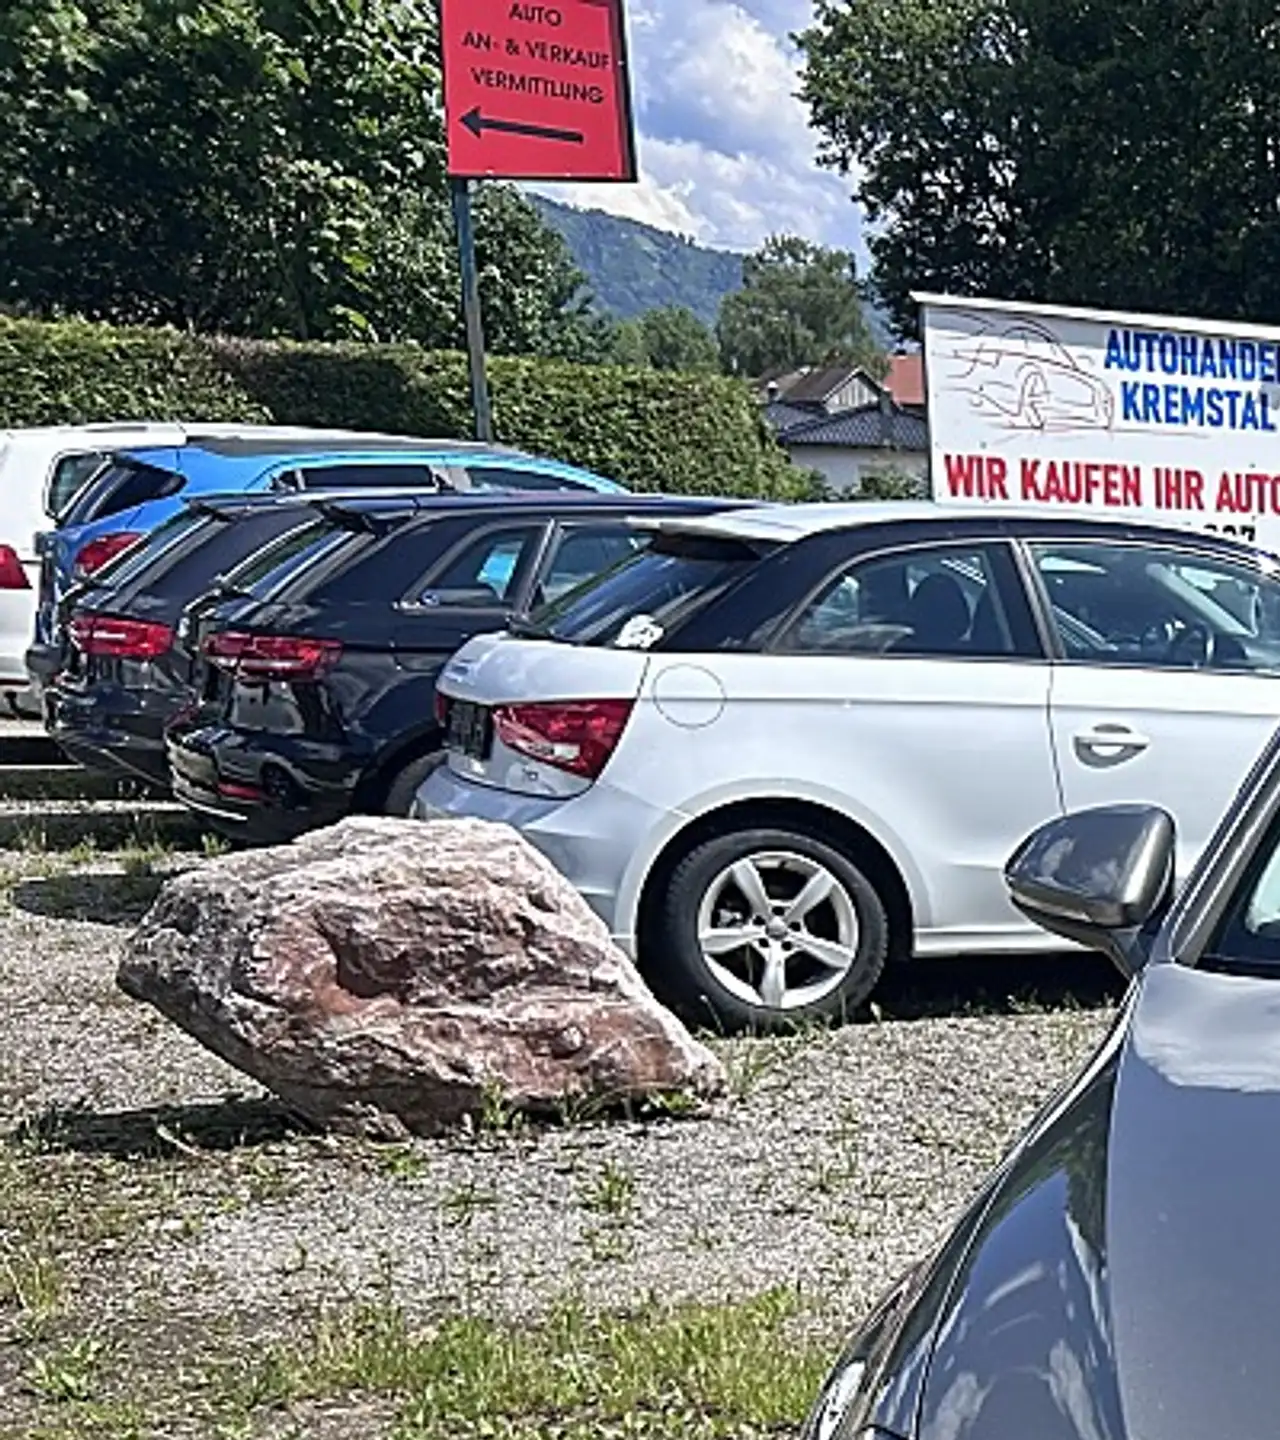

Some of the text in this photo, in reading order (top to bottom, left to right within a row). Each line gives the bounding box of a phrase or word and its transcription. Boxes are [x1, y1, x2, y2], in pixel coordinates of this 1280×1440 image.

[509, 3, 561, 26] AUTO
[462, 31, 609, 69] AN- & VERKAUF
[471, 67, 604, 104] VERMITTLUNG
[1121, 380, 1278, 432] KREMSTAL
[944, 454, 1009, 500] WIR
[1020, 458, 1143, 508] KAUFEN
[1154, 467, 1204, 511] IHR
